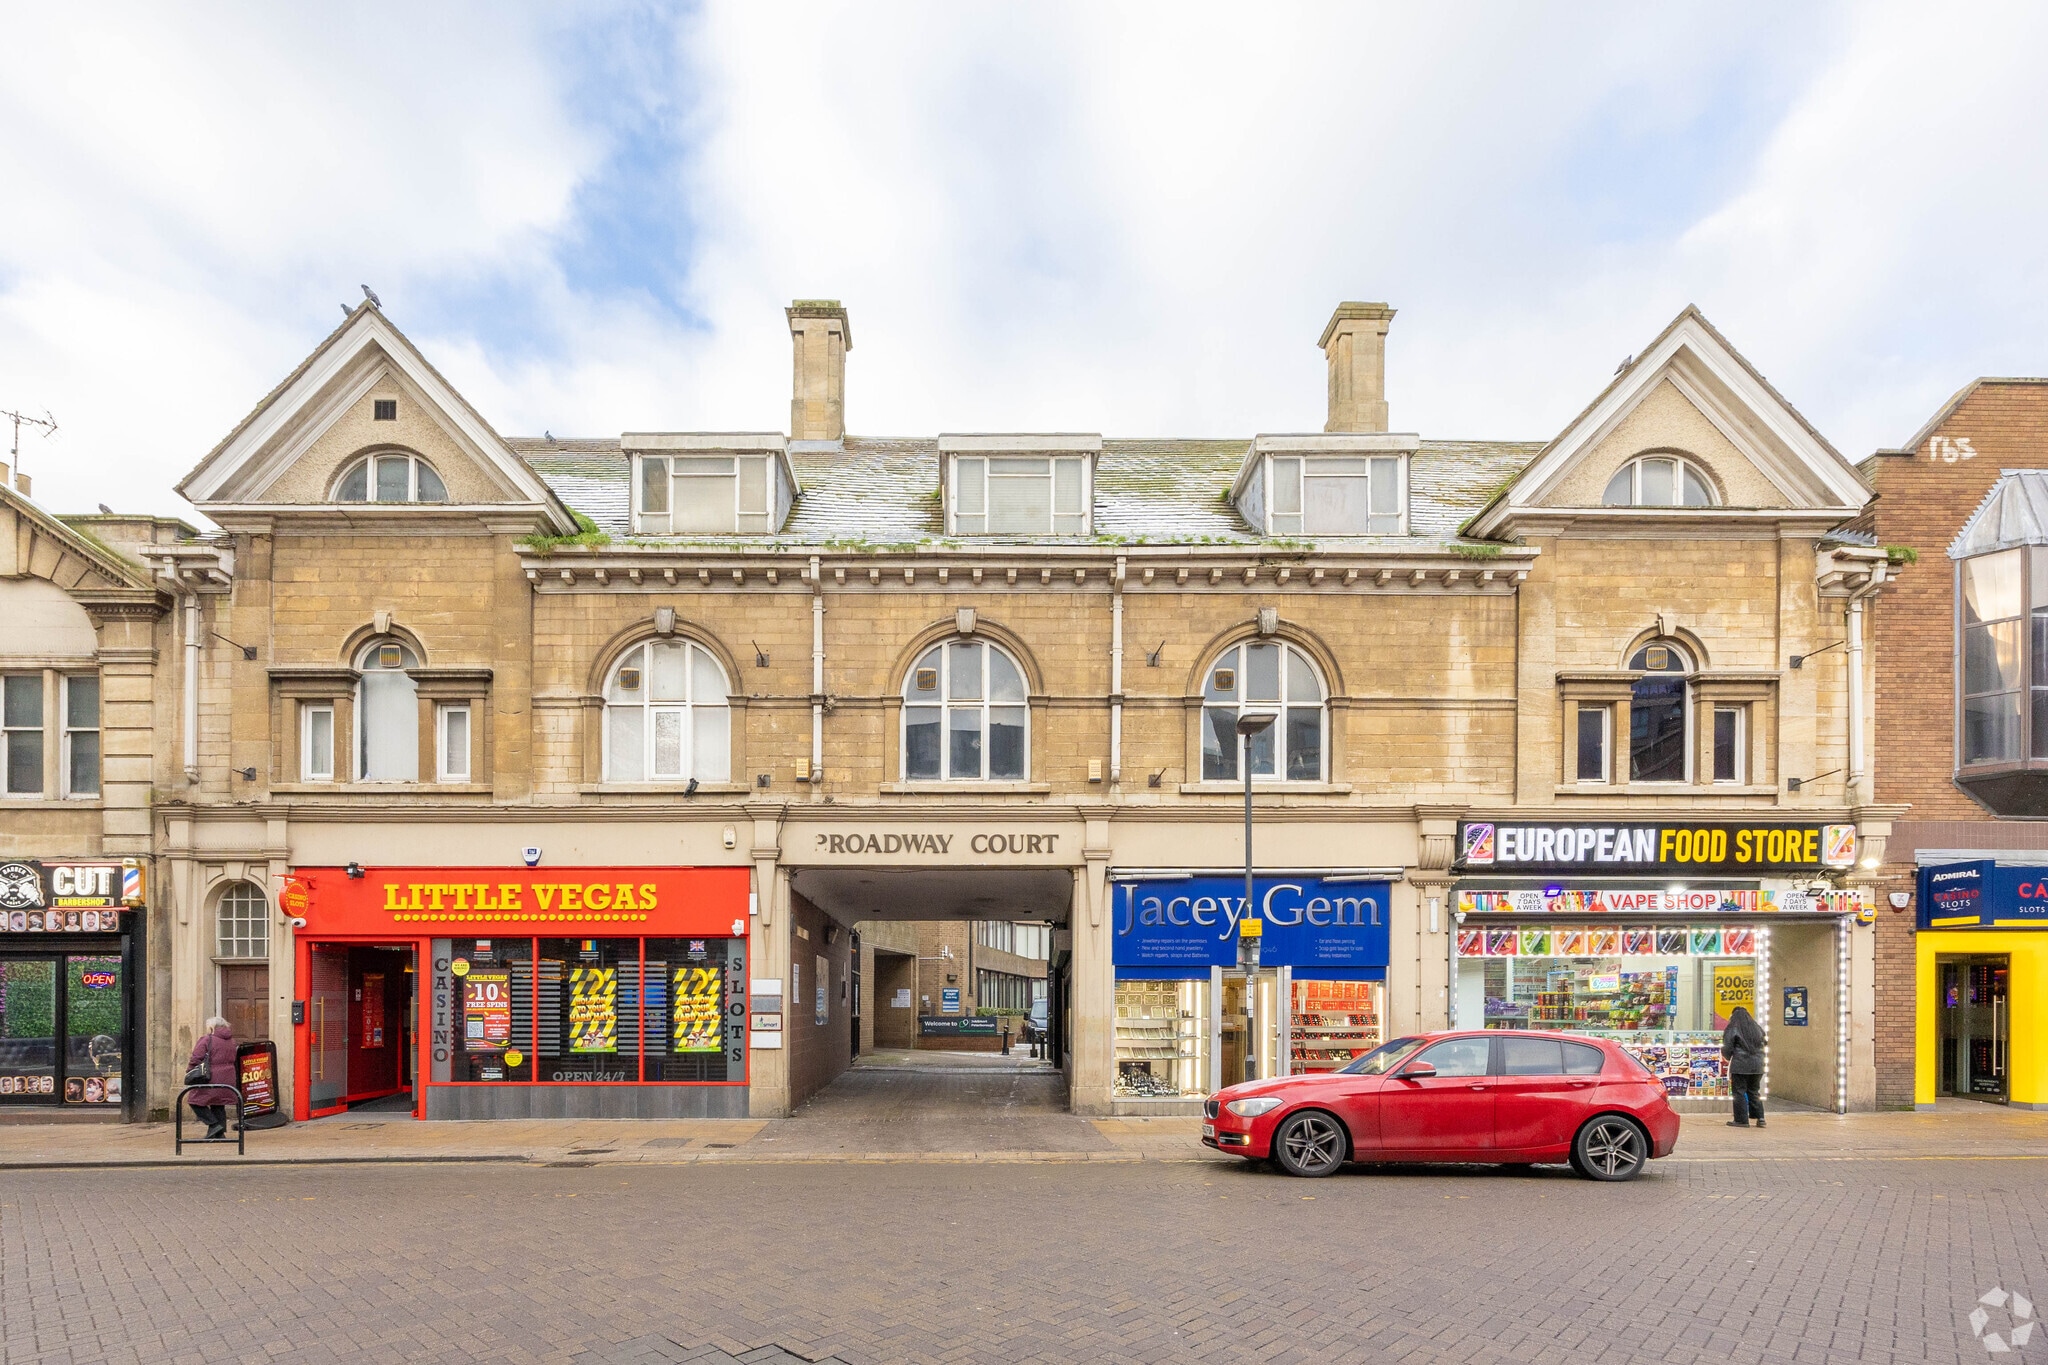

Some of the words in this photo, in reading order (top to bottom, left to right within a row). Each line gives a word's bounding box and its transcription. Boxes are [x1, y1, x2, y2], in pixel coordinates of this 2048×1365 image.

[971, 834, 1060, 854] COURT
[1497, 827, 1656, 862] EUROPEAN
[1660, 829, 1727, 863] FOOD
[1735, 829, 1819, 863] STORE
[53, 867, 114, 895] CUT
[1932, 869, 1980, 882] ADMIRAL
[58, 898, 106, 906] BARBERSHOP
[383, 884, 522, 910] LITTLE
[531, 884, 657, 910] VEGAS
[1609, 894, 1658, 910] VAPE
[1664, 894, 1716, 911] SHOP
[1933, 889, 1980, 903] CASINO
[1940, 899, 1971, 909] SLOTS
[1118, 884, 1246, 941] Jacey
[1262, 884, 1382, 926] Gem
[83, 974, 115, 984] OPEN
[1715, 976, 1754, 989] 200GB
[474, 983, 499, 1001] 10
[1720, 989, 1754, 1001] £20?!
[576, 997, 595, 1005] HOLD
[679, 996, 699, 1005] HOLD
[433, 958, 449, 1063] CASINO
[577, 1005, 587, 1013] TO
[588, 1005, 607, 1013] YOUR
[681, 1004, 692, 1012] TO
[692, 1004, 710, 1012] YOUR
[730, 957, 745, 1062] SLOTS
[569, 1013, 592, 1022] HARD
[594, 1012, 616, 1021] HATS
[673, 1012, 696, 1022] HARD
[698, 1012, 719, 1021] HATS
[552, 1071, 593, 1082] OPEN
[595, 1071, 626, 1082] 24/7
